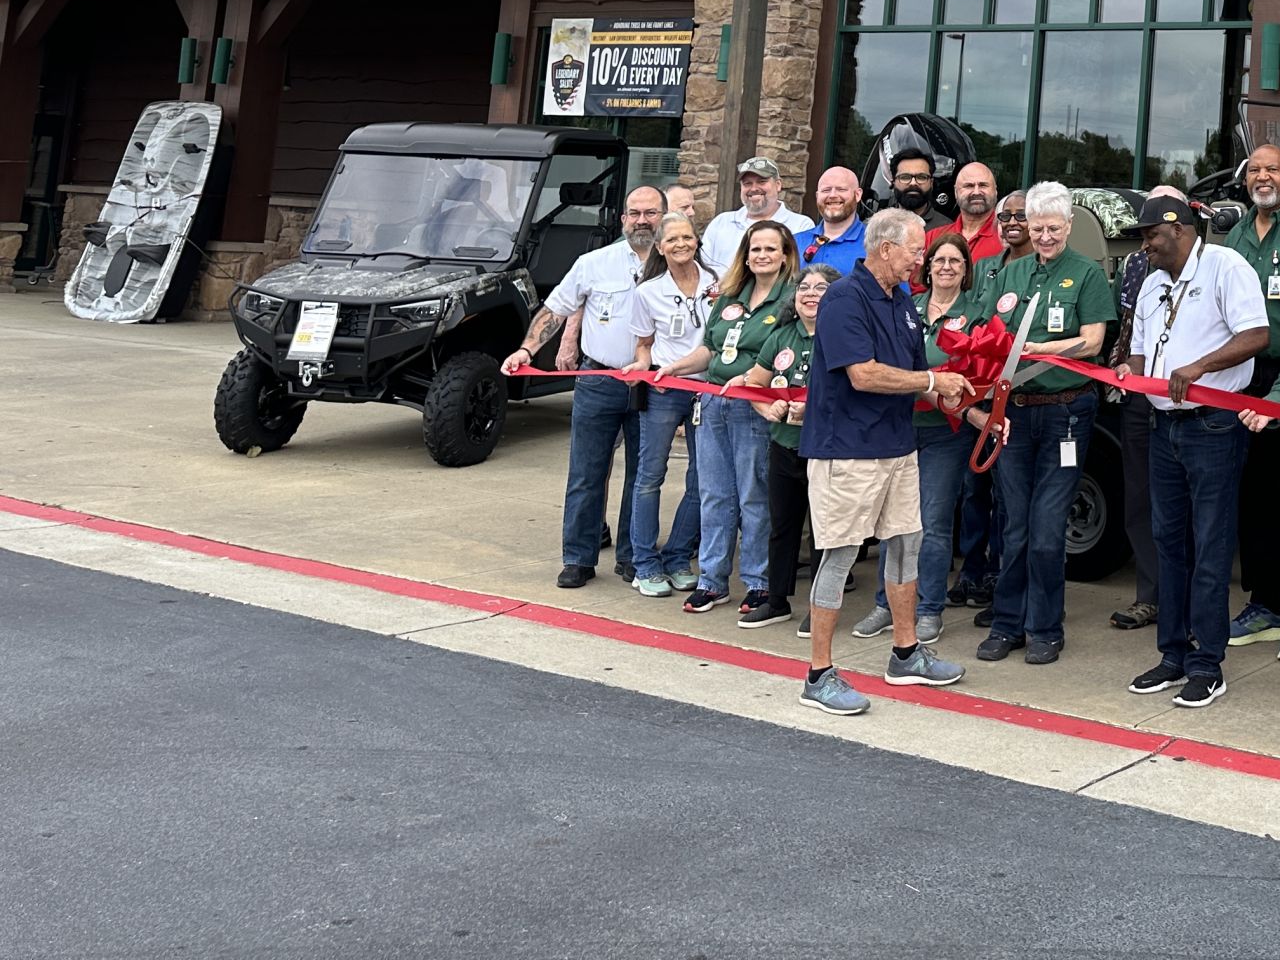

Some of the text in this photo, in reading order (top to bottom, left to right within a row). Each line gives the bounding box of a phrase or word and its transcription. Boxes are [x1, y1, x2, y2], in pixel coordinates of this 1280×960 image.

[631, 47, 681, 65] DISCOUNT
[555, 68, 580, 79] LEGENDARY
[592, 47, 628, 85] 10%
[629, 67, 683, 85] EVERY DAY
